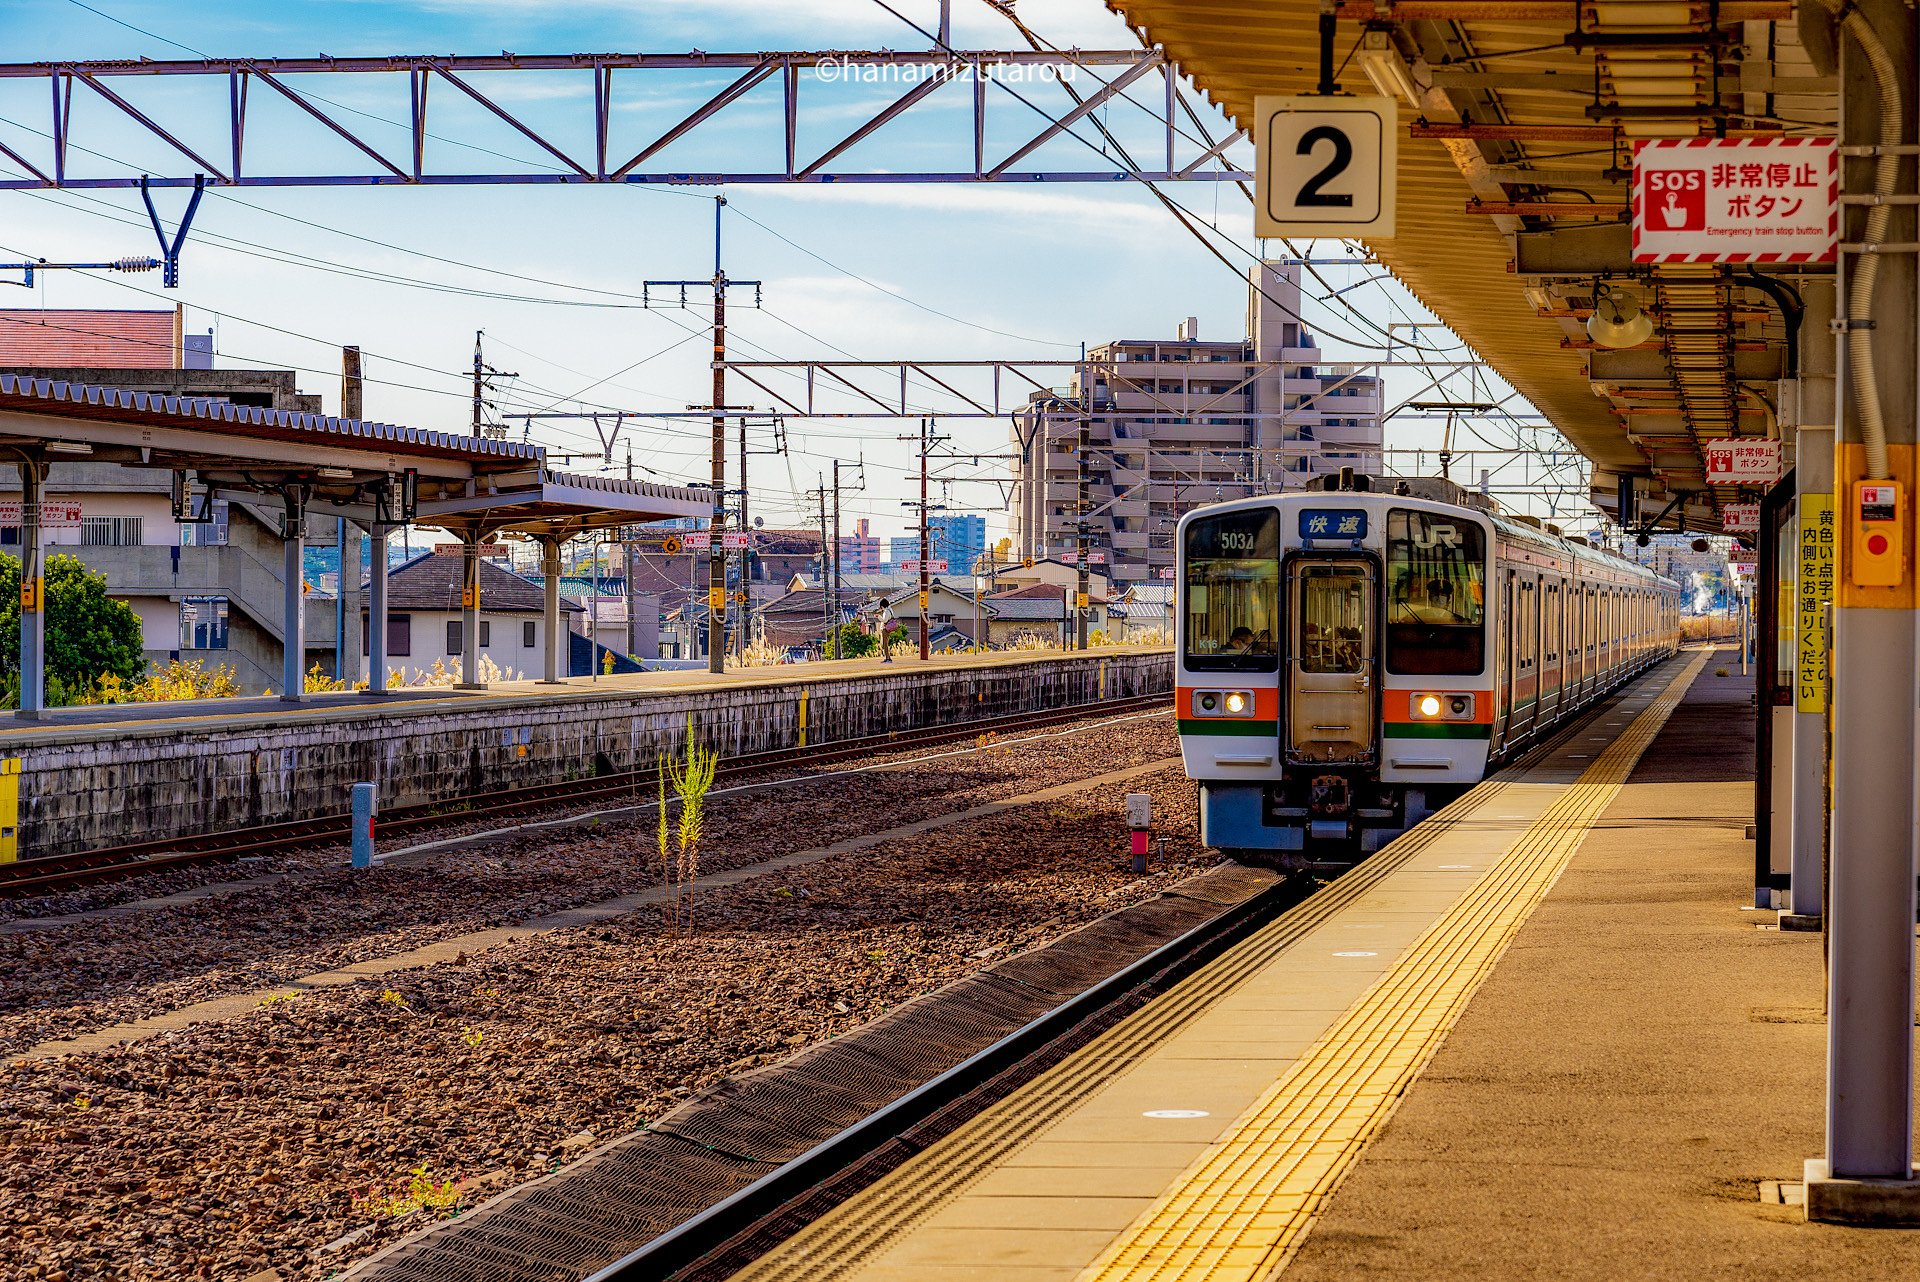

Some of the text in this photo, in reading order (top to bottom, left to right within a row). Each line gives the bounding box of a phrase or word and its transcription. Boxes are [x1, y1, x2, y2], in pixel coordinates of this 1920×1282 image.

[1294, 125, 1353, 207] 2
[1650, 172, 1700, 191] SOS
[1712, 163, 1818, 189] 非常停止
[1727, 194, 1803, 219] ボタン
[1706, 226, 1824, 238] Emergency train stop button
[1712, 450, 1731, 459] SOS
[1735, 447, 1774, 457] 非常停止
[1740, 459, 1769, 468] ボタン
[1308, 516, 1361, 534] 快速
[1414, 525, 1456, 549] JR
[666, 540, 676, 551] 6
[1025, 559, 1032, 568] 8
[737, 594, 744, 603] 8
[1802, 527, 1817, 699] 内側をお通りください
[1199, 639, 1218, 649] K16
